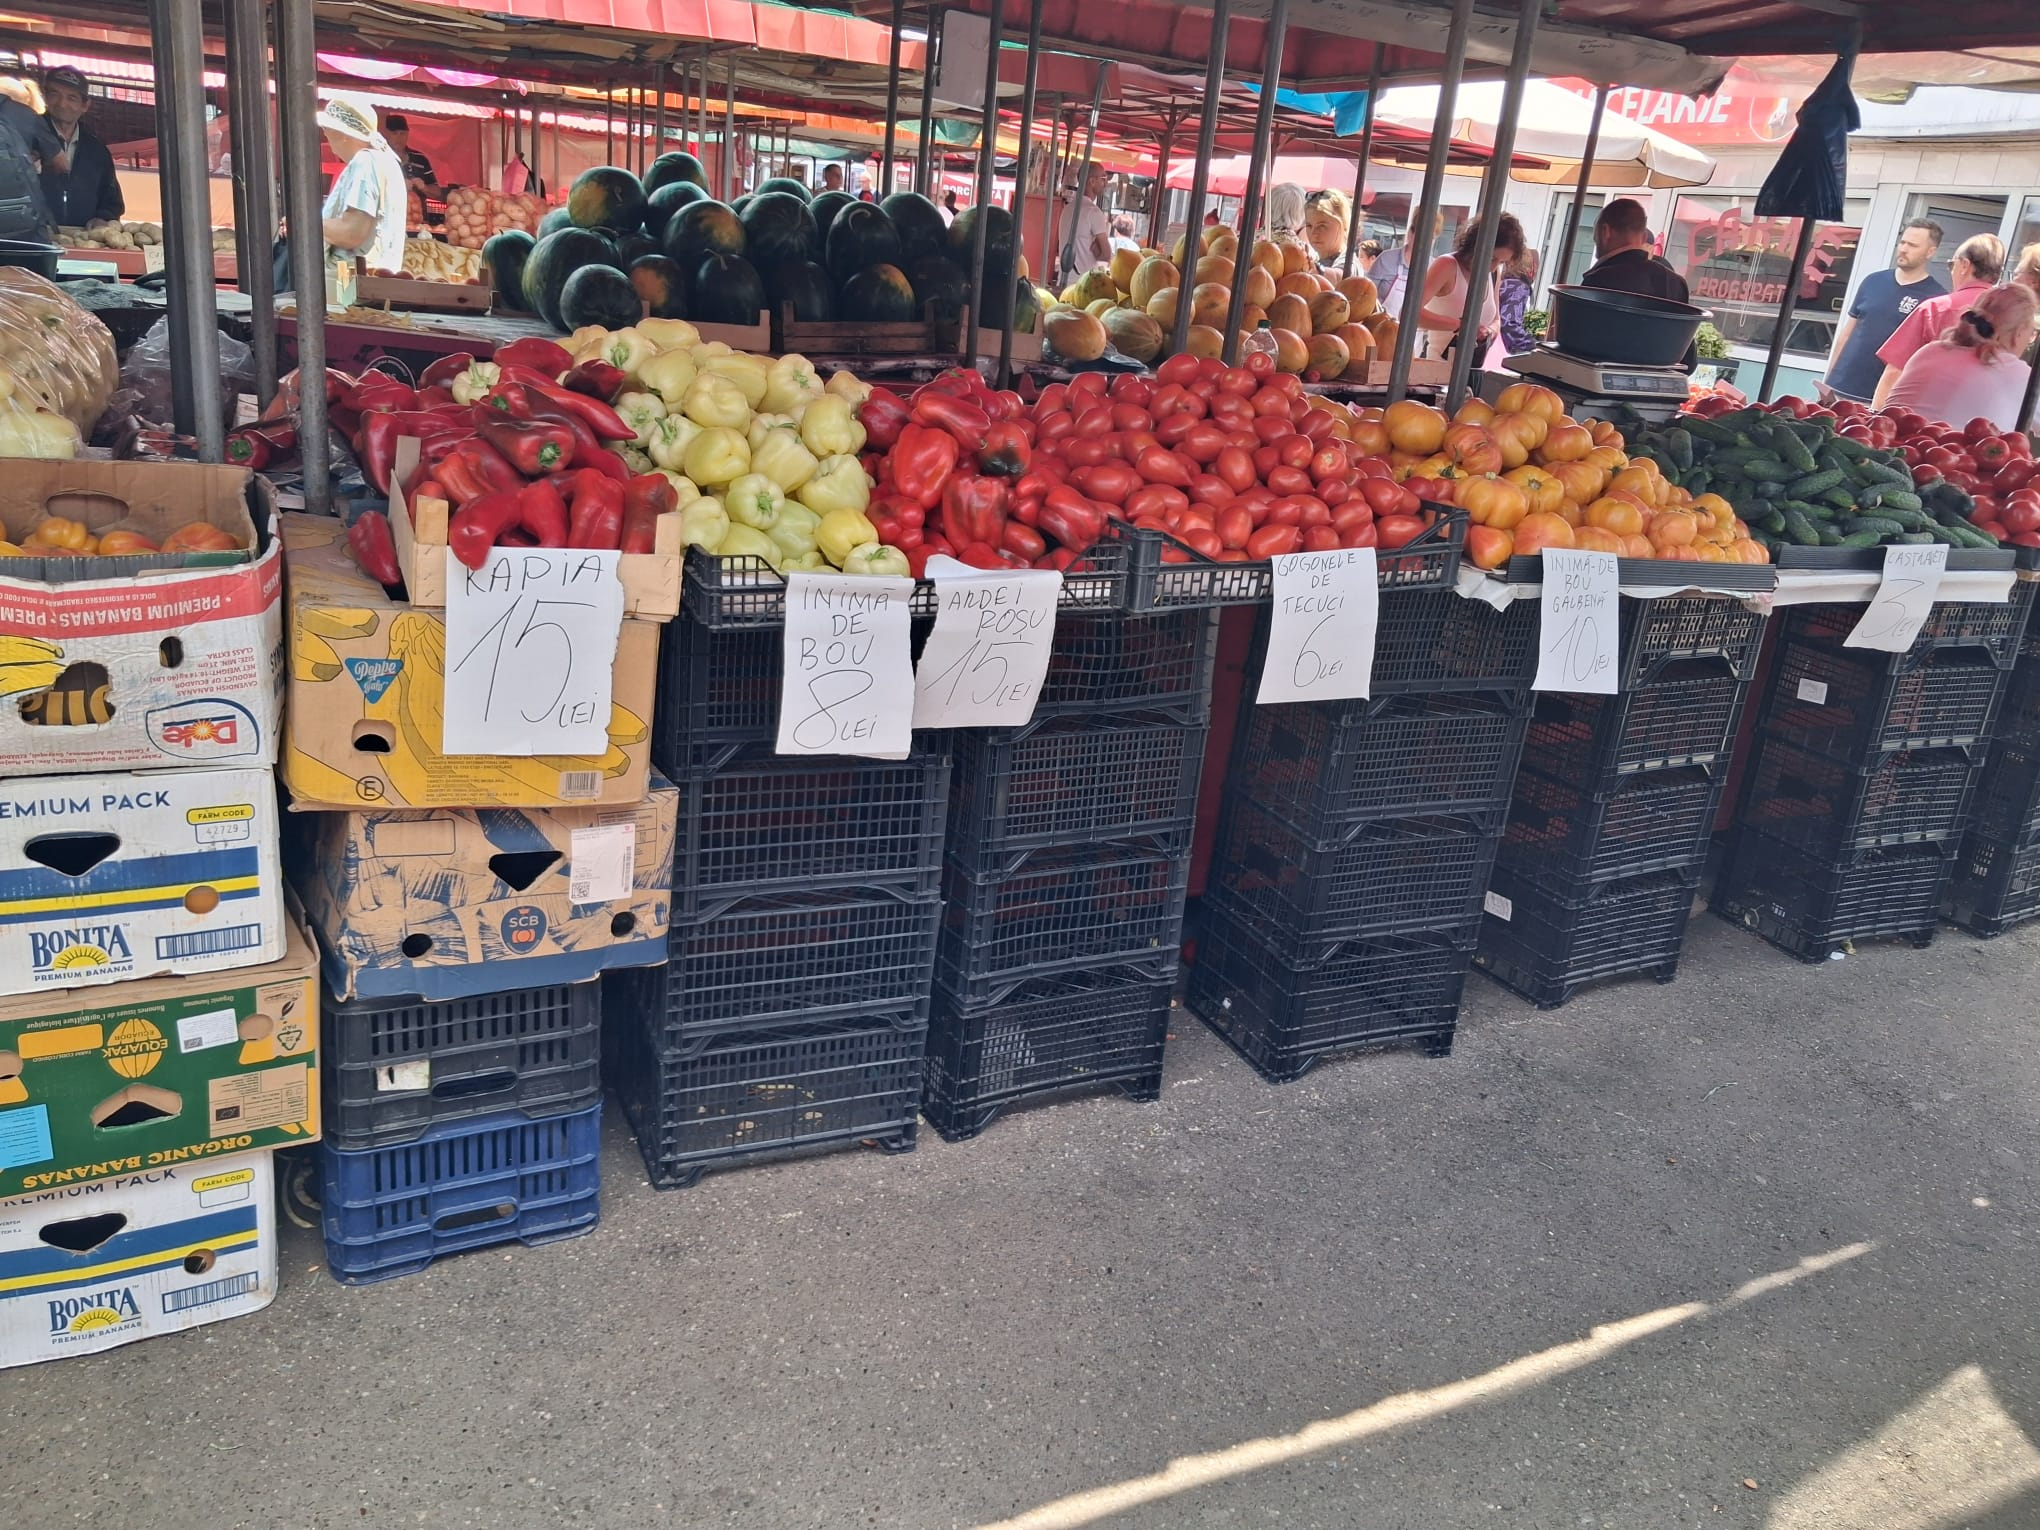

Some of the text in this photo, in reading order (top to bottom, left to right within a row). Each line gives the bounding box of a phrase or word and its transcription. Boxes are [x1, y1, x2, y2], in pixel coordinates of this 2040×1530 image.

[1311, 573, 1331, 589] DE
[1565, 575, 1592, 593] BOU
[147, 595, 221, 620] PREMIUM
[948, 583, 1022, 610] ARDEI
[1283, 590, 1345, 615] TECUCI
[60, 605, 142, 628] BANANAS
[832, 612, 868, 637] DE
[207, 647, 254, 660] CLASS EXTRA
[800, 634, 875, 670] BOU
[1293, 614, 1345, 688] 6 LEI
[1550, 614, 1599, 684] 10
[452, 595, 599, 729] 15 LEI
[924, 640, 1034, 707] 15 LEI
[175, 679, 209, 689] ECUADOR
[224, 672, 257, 682] PRODUCT
[176, 681, 258, 697] CAVENDISH BANANAS
[793, 669, 877, 749] 8 LEI
[162, 720, 237, 748] Dole
[102, 790, 171, 812] PACK
[197, 809, 245, 820] FARM CODE
[509, 915, 539, 928] SCB
[28, 924, 132, 969] BONITA
[34, 964, 134, 982] PREMIUM BANANAS
[107, 1011, 115, 1019] de
[114, 1029, 154, 1041] ECUADOR
[100, 1038, 168, 1058] EQUAPAK
[21, 1134, 253, 1189] ORGANIC BANANAS
[201, 1173, 247, 1189] FARM CODE
[47, 1286, 142, 1332] BONITA
[51, 1321, 142, 1345] PREMIUM BANANAS
